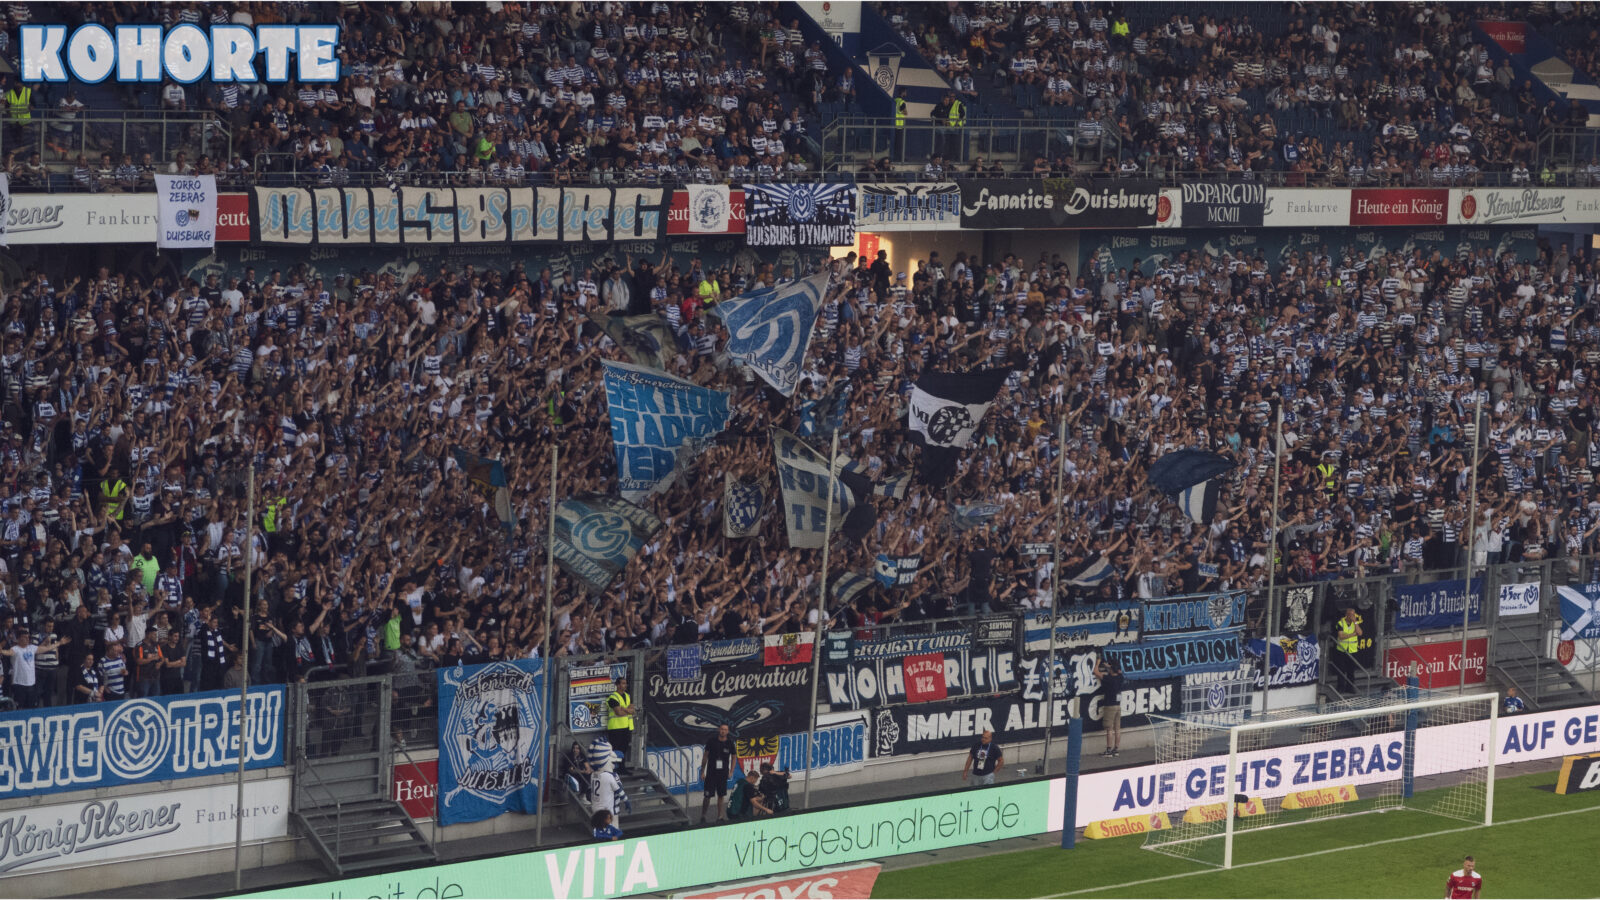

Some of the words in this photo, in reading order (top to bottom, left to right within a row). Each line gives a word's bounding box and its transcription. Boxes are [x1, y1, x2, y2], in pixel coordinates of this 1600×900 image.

[170, 180, 201, 190] ZORRO
[1182, 183, 1265, 204] DISPARGUM
[169, 191, 205, 203] ZEBRAS
[962, 188, 1054, 217] Fanatics
[1063, 187, 1158, 216] Duisburg
[1286, 200, 1338, 213] Fankurve
[1357, 199, 1388, 214] Heute
[1392, 199, 1408, 213] ein
[1411, 198, 1443, 219] König
[1484, 191, 1520, 219] König
[1519, 188, 1565, 213] Pilsener
[1207, 206, 1240, 223] MCMII
[166, 230, 212, 242] DUISBURG
[746, 223, 796, 246] DUISBURG
[799, 223, 855, 246] DYNAMITES
[606, 379, 730, 418] SEKTION
[702, 639, 760, 662] Freundeskreis
[1103, 636, 1239, 674] WEDAUSTADION
[570, 666, 611, 679] SEKTION
[827, 652, 1014, 706] KOHRTE
[906, 660, 943, 676] ULTRAS
[455, 668, 536, 707] Hafenstadt
[650, 674, 706, 698] Proud
[711, 667, 809, 697] Generation
[915, 675, 936, 693] MZ
[907, 707, 996, 743] IMMER
[1087, 684, 1173, 722] GBEN!
[168, 690, 282, 773] TREU
[1502, 720, 1556, 755] AUF
[1563, 714, 1599, 746] GE
[1112, 772, 1176, 812] AUF
[1292, 740, 1403, 786] ZEBRAS
[1296, 791, 1336, 809] Sinalco
[0, 814, 79, 857] König
[78, 799, 181, 845] Pilsener
[195, 803, 280, 824] Fankurve
[1100, 818, 1145, 839] Sinalco
[544, 839, 660, 899] VITA
[734, 796, 1021, 868] vita-gesundheit.de
